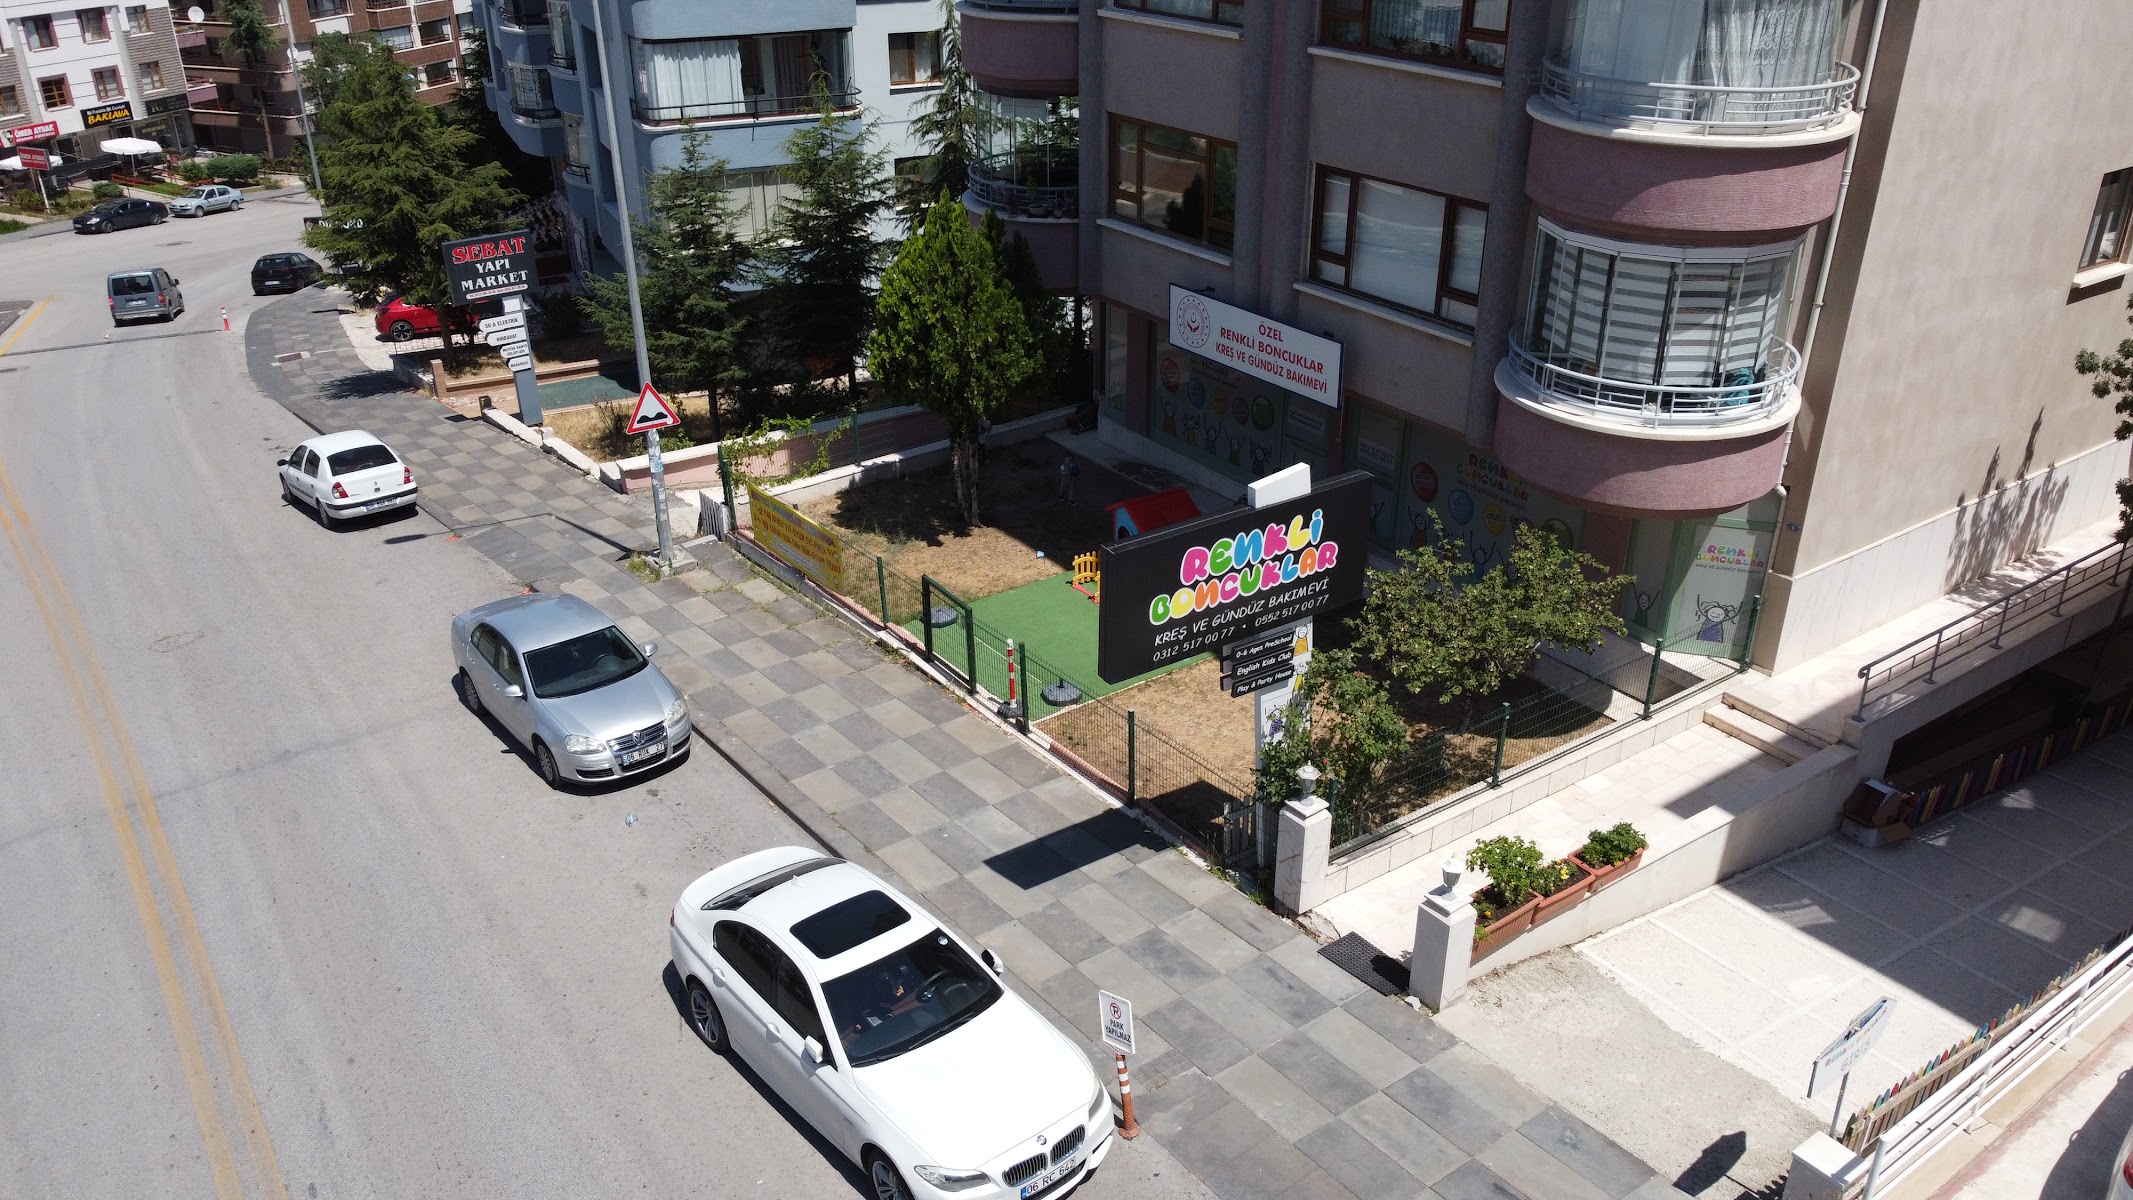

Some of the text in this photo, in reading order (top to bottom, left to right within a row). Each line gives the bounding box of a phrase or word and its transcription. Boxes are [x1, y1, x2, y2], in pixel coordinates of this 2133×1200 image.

[88, 109, 130, 124] BAKLAVA
[14, 126, 31, 138] ÖMER
[452, 236, 526, 264] SEBAT
[475, 258, 510, 274] YAPI
[461, 270, 528, 291] MARKET
[1258, 320, 1284, 342] ÖZEL
[1220, 326, 1324, 374] RENKLİ BONCUKLAR
[1216, 342, 1328, 394] KREŞ VE GÜNDÜZ BAKIMEVİ
[1456, 462, 1529, 500] BONCUKLAR
[1180, 508, 1324, 586] RENKLİ
[1707, 544, 1760, 560] RENKLİ
[1696, 554, 1764, 568] BONCUKLAR
[1150, 542, 1338, 626] BONCUKLAR
[1154, 576, 1330, 646] KREŞ VE GÜNDÜZ BAKIMEVİ
[1153, 594, 1330, 662] 0312 517 00 77 0552 517 00 77
[1236, 634, 1292, 658] 0-6 Ages PreSchool
[1236, 652, 1292, 676] English Kids Club
[1237, 684, 1250, 694] Play
[1256, 676, 1274, 686] Party
[1275, 670, 1292, 680] House
[1104, 1024, 1131, 1043] YAPILMAZ
[1110, 1019, 1124, 1032] PARK
[1027, 1160, 1074, 1194] 06 RC 642
